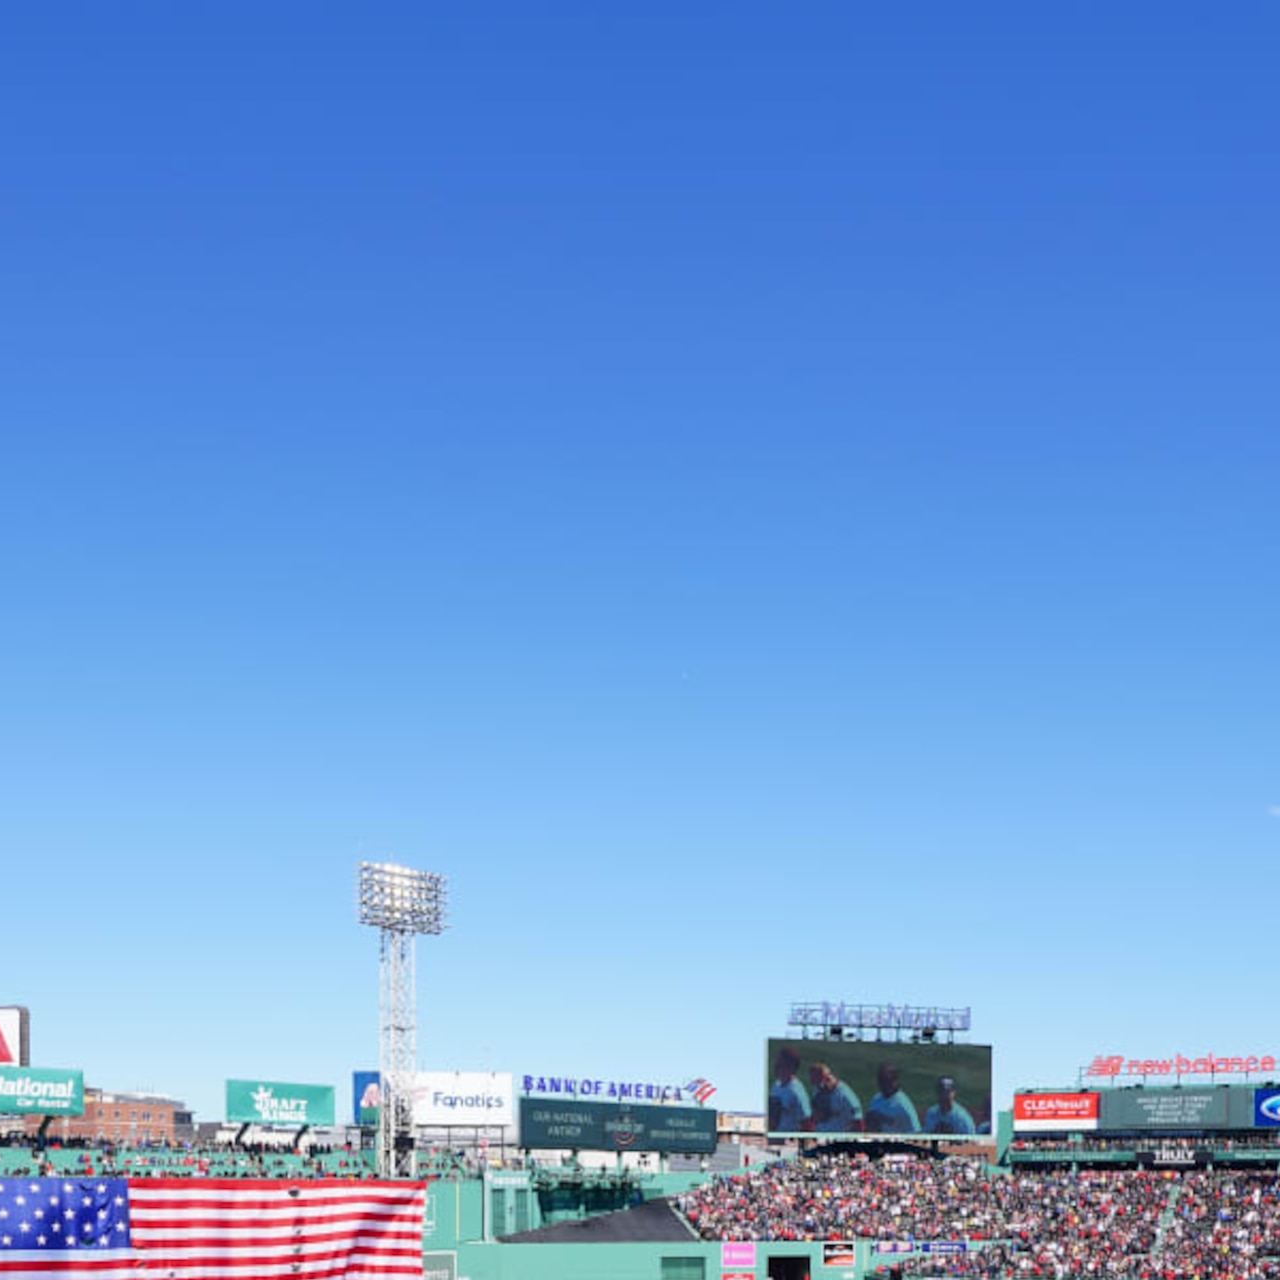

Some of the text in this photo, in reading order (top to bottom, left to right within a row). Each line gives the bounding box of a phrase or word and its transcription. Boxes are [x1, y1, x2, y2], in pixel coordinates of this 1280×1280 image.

[1127, 1058, 1171, 1075] new
[1175, 1053, 1276, 1074] balance
[523, 1075, 683, 1100] BANK OF AMERICA
[433, 1092, 504, 1109] Fanatics
[533, 1112, 594, 1124] OUR NATIONAL
[548, 1126, 581, 1137] ANTHEM
[1155, 1149, 1195, 1161] TRULY
